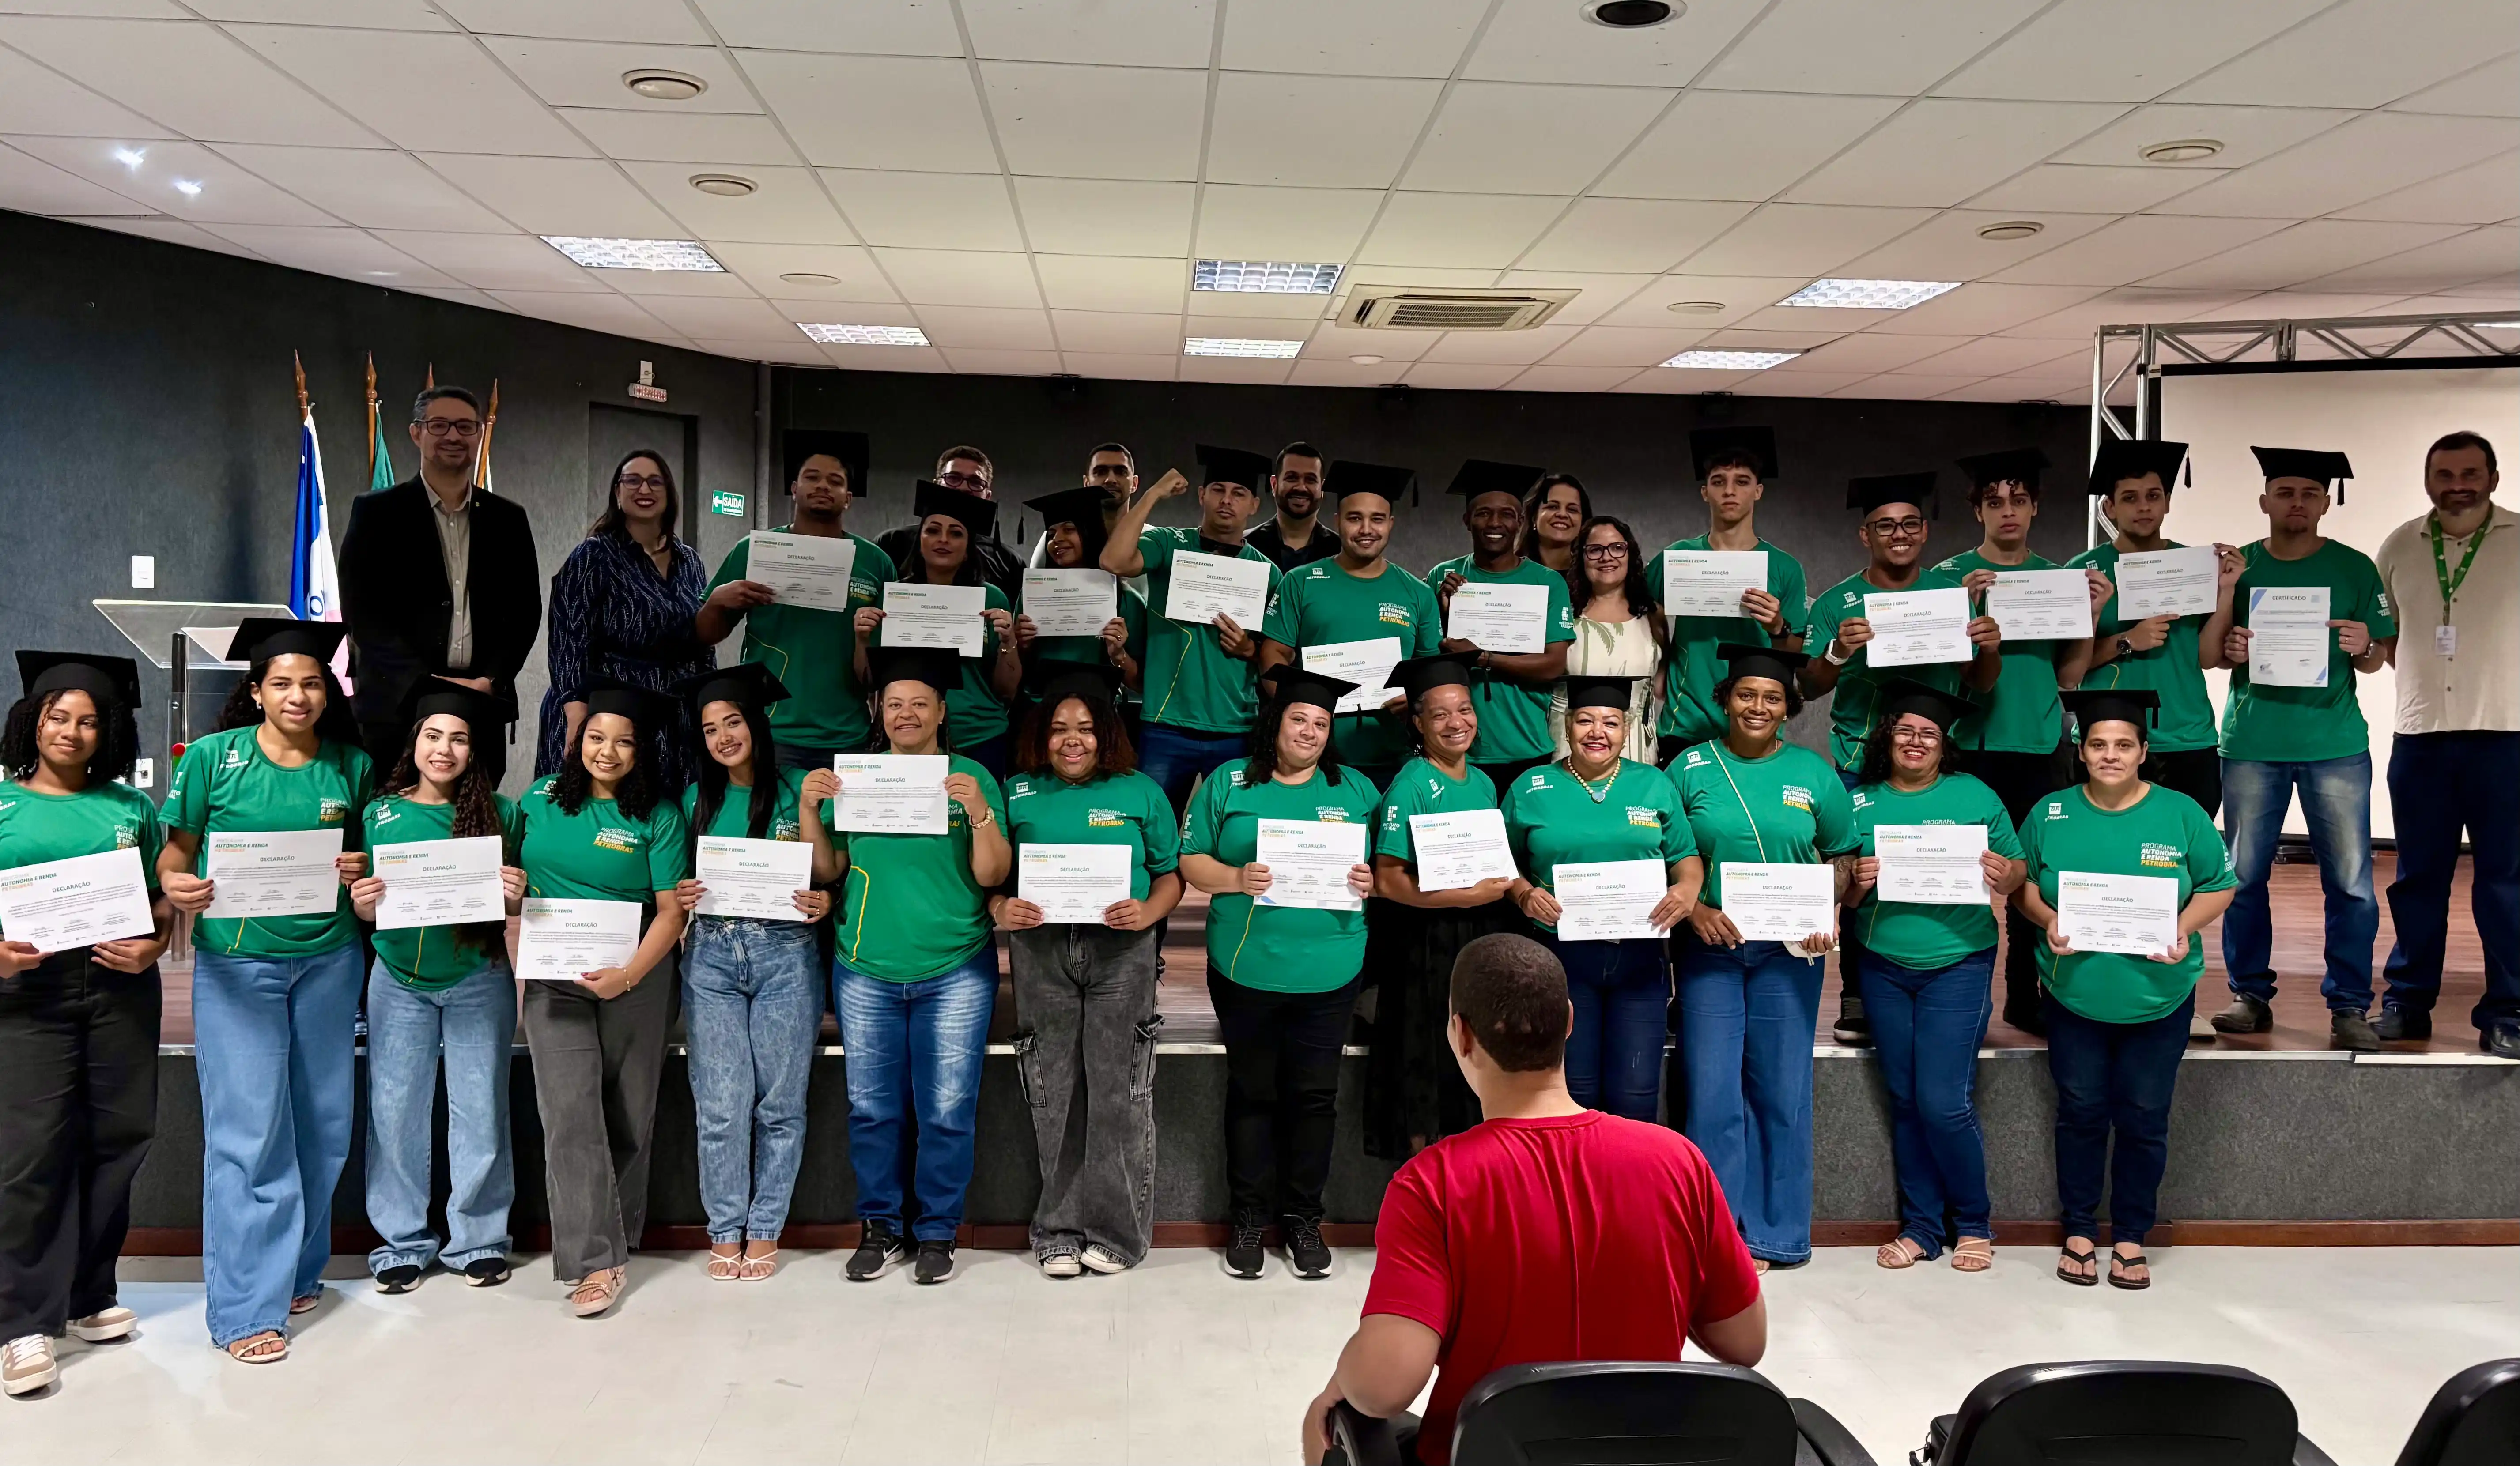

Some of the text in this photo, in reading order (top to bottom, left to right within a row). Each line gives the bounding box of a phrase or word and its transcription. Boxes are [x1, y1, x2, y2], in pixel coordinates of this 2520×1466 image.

[724, 495, 742, 509] SAÍDA
[1379, 602, 1407, 611] PROGRAMA
[1379, 607, 1410, 618] AUTONOMIA
[1379, 616, 1409, 627] PETROBRAS
[1788, 795, 1808, 805] RENDA
[601, 827, 634, 837] PROGRAMA
[597, 832, 638, 844] AUTONOMIA
[593, 840, 634, 853] PETROBRAS
[2141, 843, 2176, 851] PROGRAMA
[2141, 848, 2182, 857] AUTONOMIA
[0, 877, 33, 886] AUTONOMIA
[52, 882, 90, 893] DECLARAÇÃO
